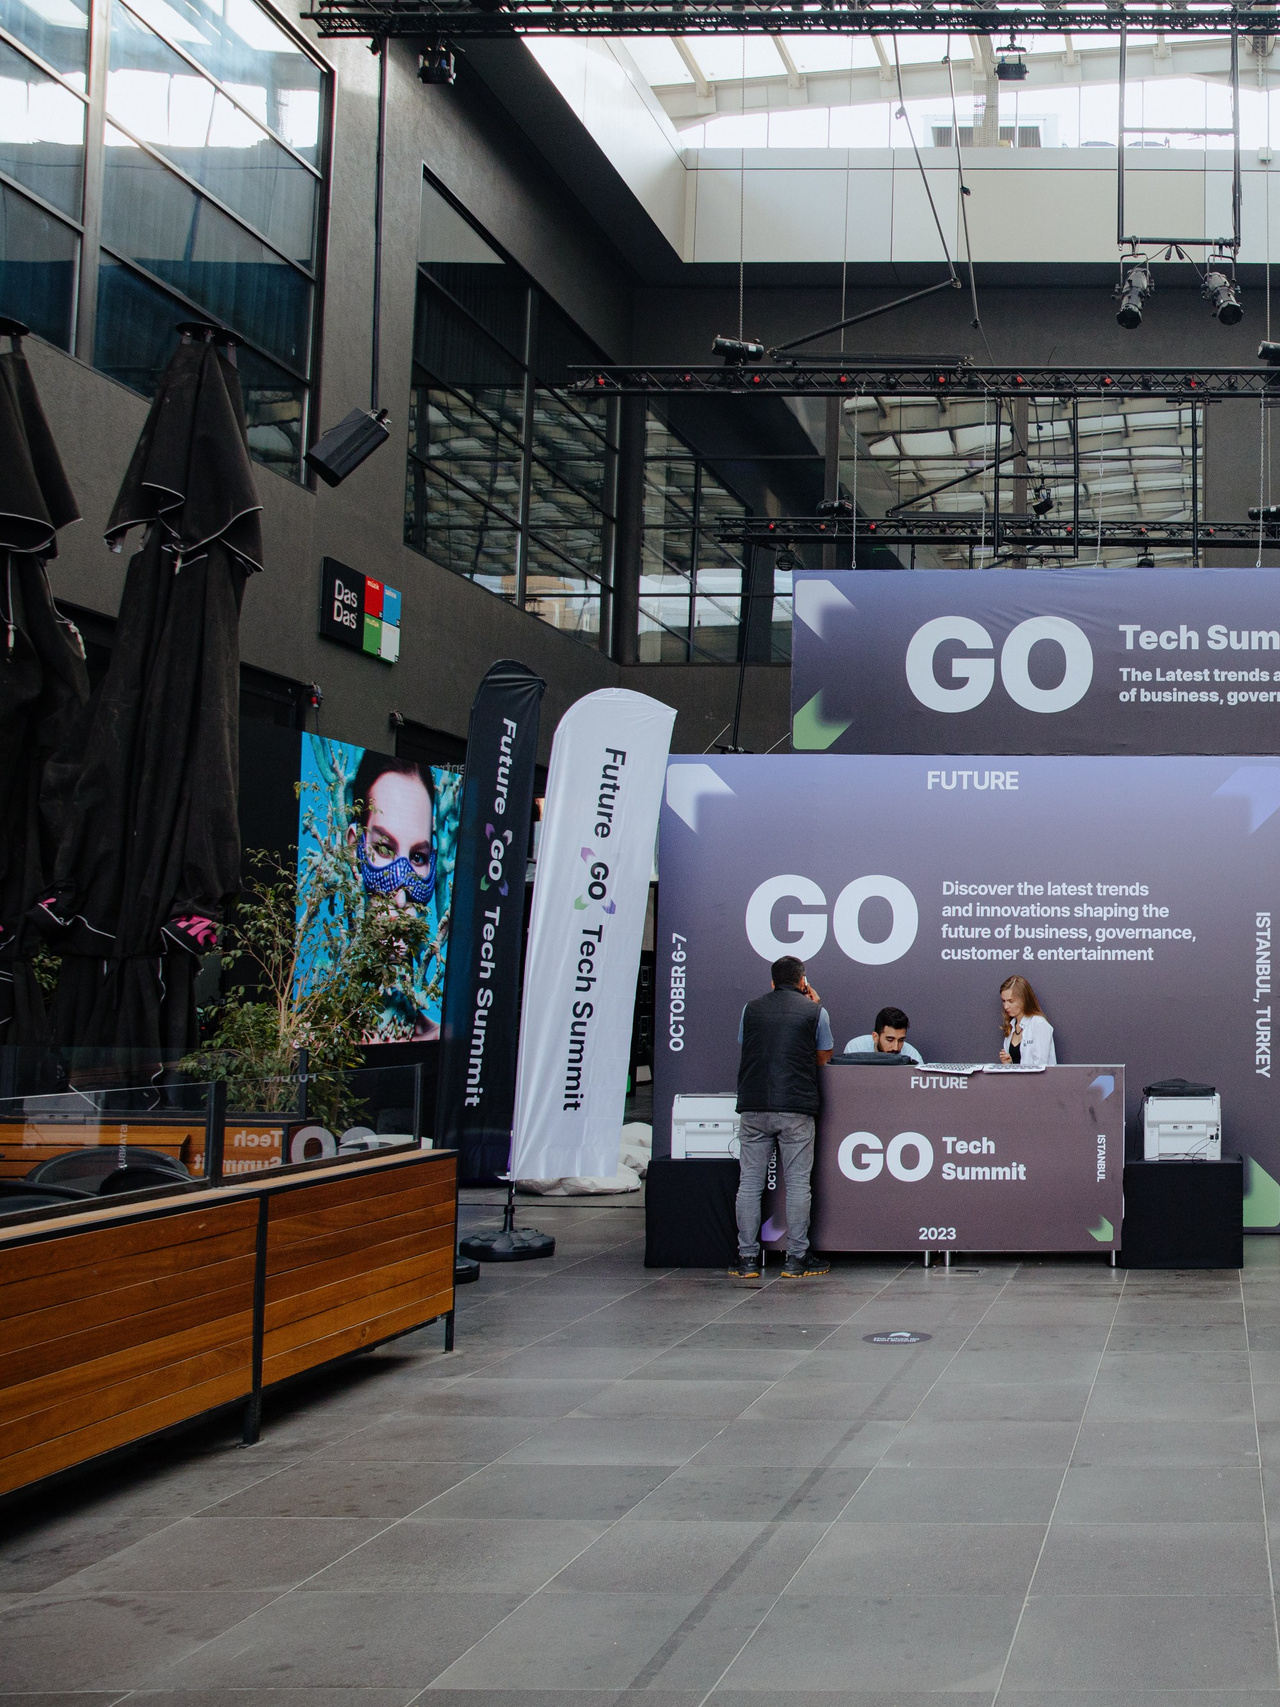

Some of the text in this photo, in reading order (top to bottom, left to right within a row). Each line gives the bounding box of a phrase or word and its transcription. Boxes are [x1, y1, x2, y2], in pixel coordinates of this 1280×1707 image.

[334, 578, 358, 608] Das
[333, 599, 358, 630] Das
[1118, 624, 1200, 650] Tech
[905, 615, 1094, 714] GO
[1118, 667, 1153, 682] The
[1155, 667, 1211, 682] Latest
[1212, 667, 1271, 682] trends
[1118, 687, 1138, 702] of
[1140, 687, 1224, 706] business,
[494, 717, 517, 815] Future
[927, 770, 1019, 790] FUTURE
[594, 747, 627, 838] Future
[488, 839, 505, 881] GO
[588, 861, 609, 901] GO
[942, 880, 1150, 897] Discover the latest trends
[745, 874, 919, 966] GO
[941, 901, 1170, 921] and innovations shaping the
[941, 923, 1197, 943] future of business, governance,
[941, 945, 1154, 961] customer & entertainment
[465, 906, 500, 1107] Tech Summit
[668, 933, 687, 1052] OCTOBER 6-7
[1253, 911, 1271, 1079] ISTANBUL, TURKEY
[563, 924, 604, 1111] Tech Summit
[910, 1076, 968, 1089] FUTURE
[837, 1131, 934, 1183] GO
[941, 1136, 996, 1155] Tech
[1096, 1134, 1106, 1183] ISTANBUL
[941, 1161, 1027, 1181] Summit
[918, 1227, 957, 1241] 2023
